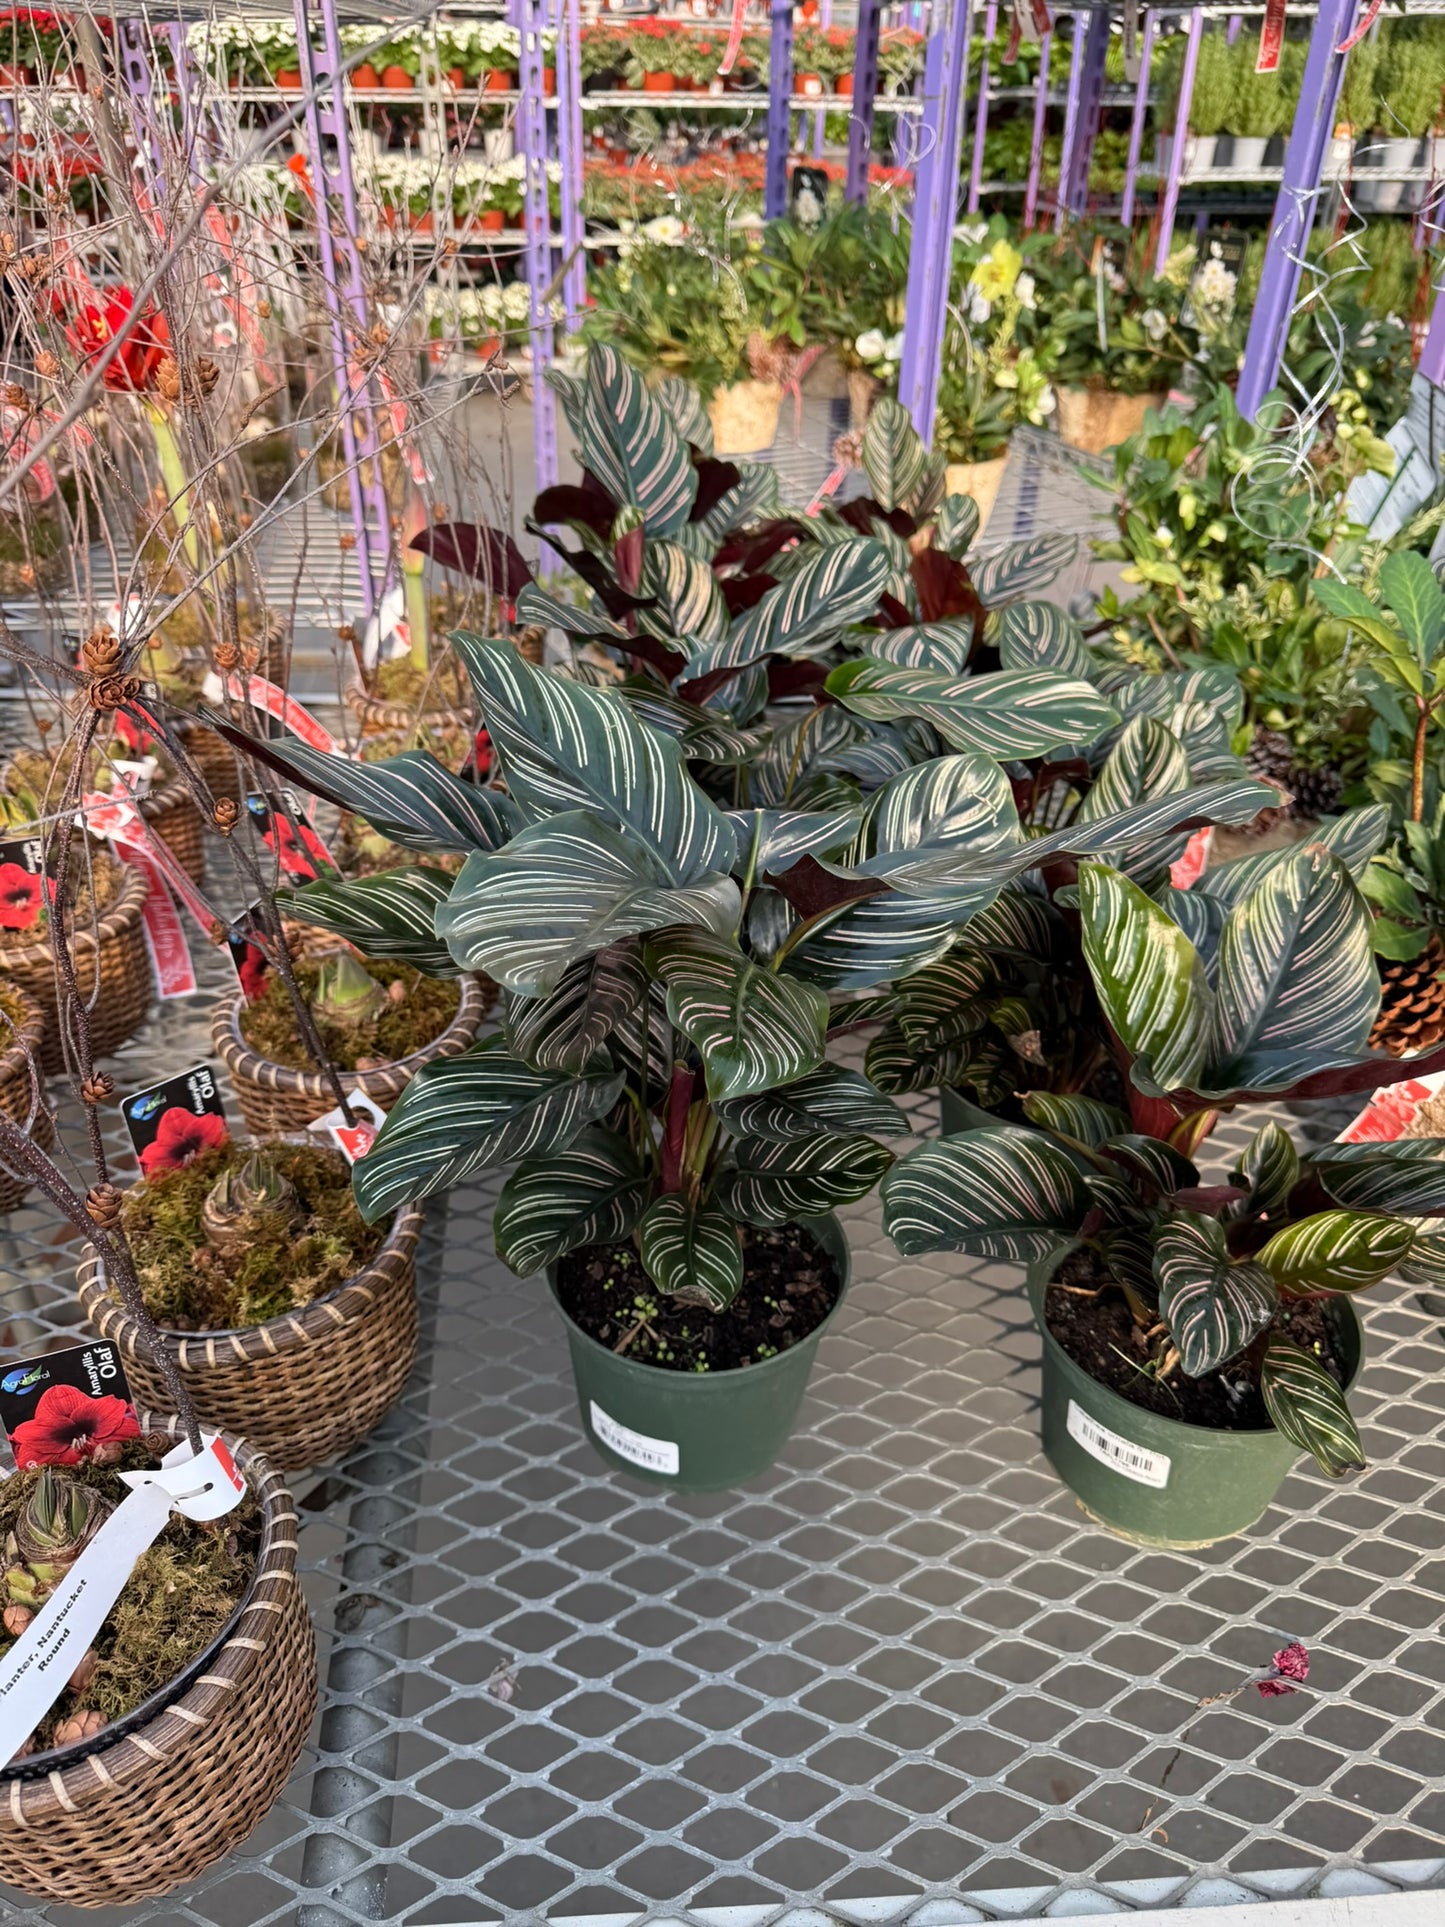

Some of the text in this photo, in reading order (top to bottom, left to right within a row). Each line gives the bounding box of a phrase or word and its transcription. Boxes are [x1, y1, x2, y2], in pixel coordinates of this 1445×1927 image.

[194, 1070, 215, 1099] Olaf
[82, 1351, 103, 1396] Amaryllis
[93, 1346, 118, 1379] Olaf
[0, 1578, 88, 1697] lanter, Nantucket
[37, 1627, 71, 1673] Round
